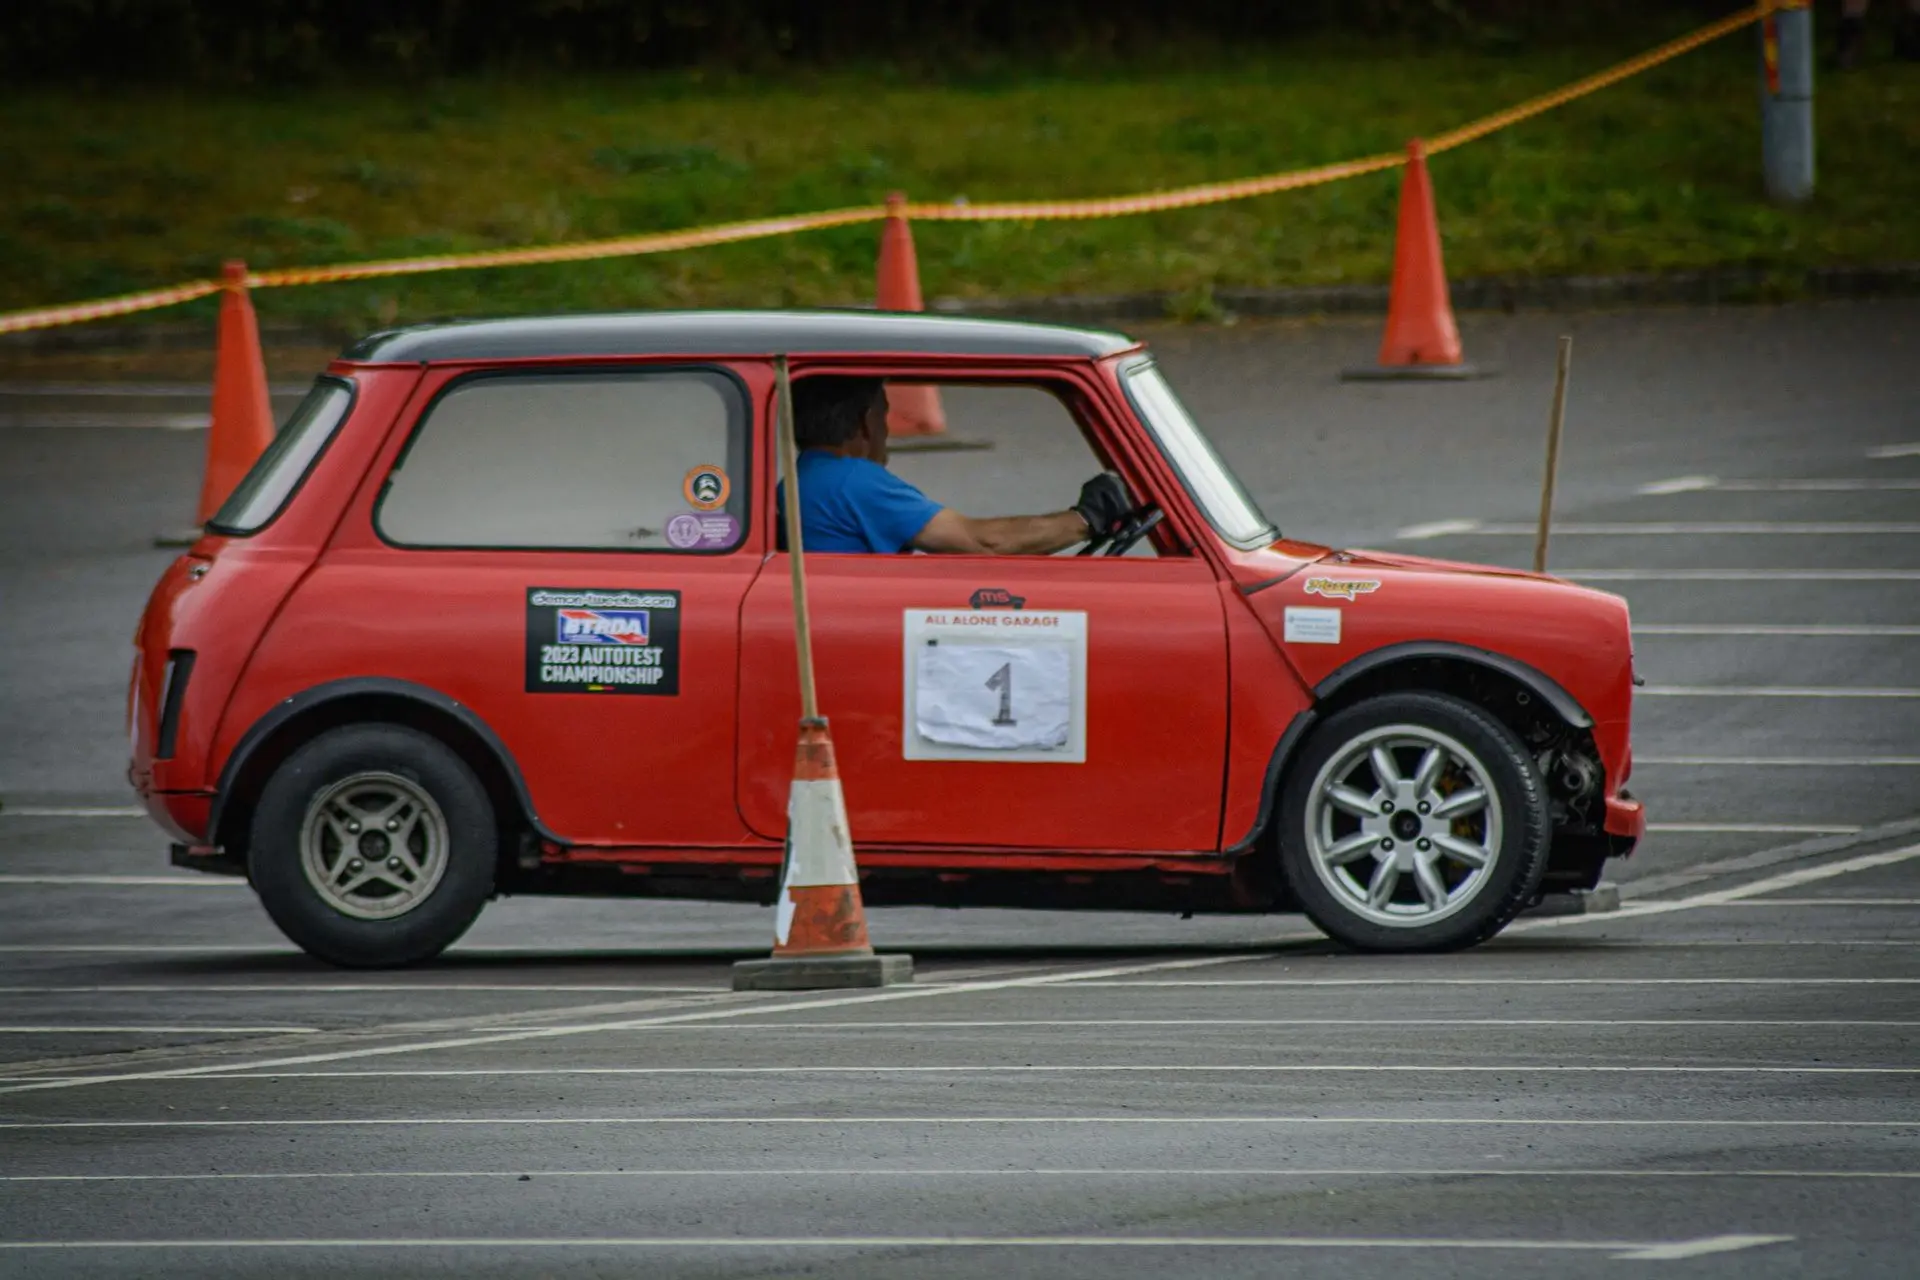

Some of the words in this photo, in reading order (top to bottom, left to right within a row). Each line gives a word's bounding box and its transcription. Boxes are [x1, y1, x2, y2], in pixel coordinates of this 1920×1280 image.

[925, 615, 948, 625] ALL
[952, 615, 998, 626] ALONE
[1002, 616, 1060, 627] GARAGE
[541, 645, 580, 663] 2023
[582, 646, 663, 666] AUTOTEST
[541, 665, 664, 685] CHAMPIONSHIP
[984, 662, 1017, 727] 1
